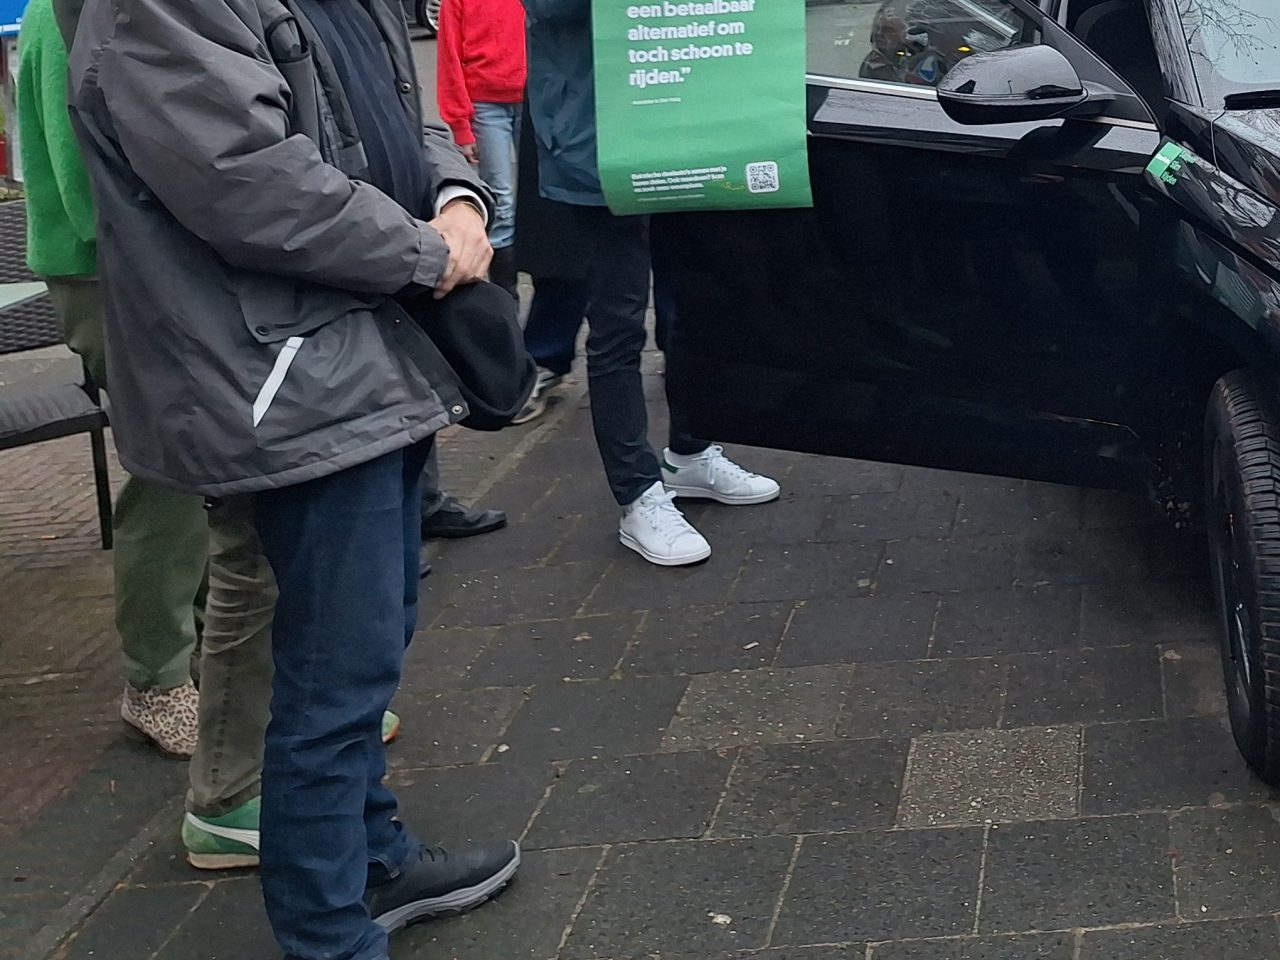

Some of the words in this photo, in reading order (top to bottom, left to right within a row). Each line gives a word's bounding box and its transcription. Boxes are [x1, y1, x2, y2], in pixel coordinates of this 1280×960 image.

[626, 4, 663, 19] een
[627, 21, 716, 41] alternatief
[717, 22, 745, 35] om
[628, 45, 669, 63] toch
[670, 43, 734, 61] schoon
[735, 42, 754, 56] te
